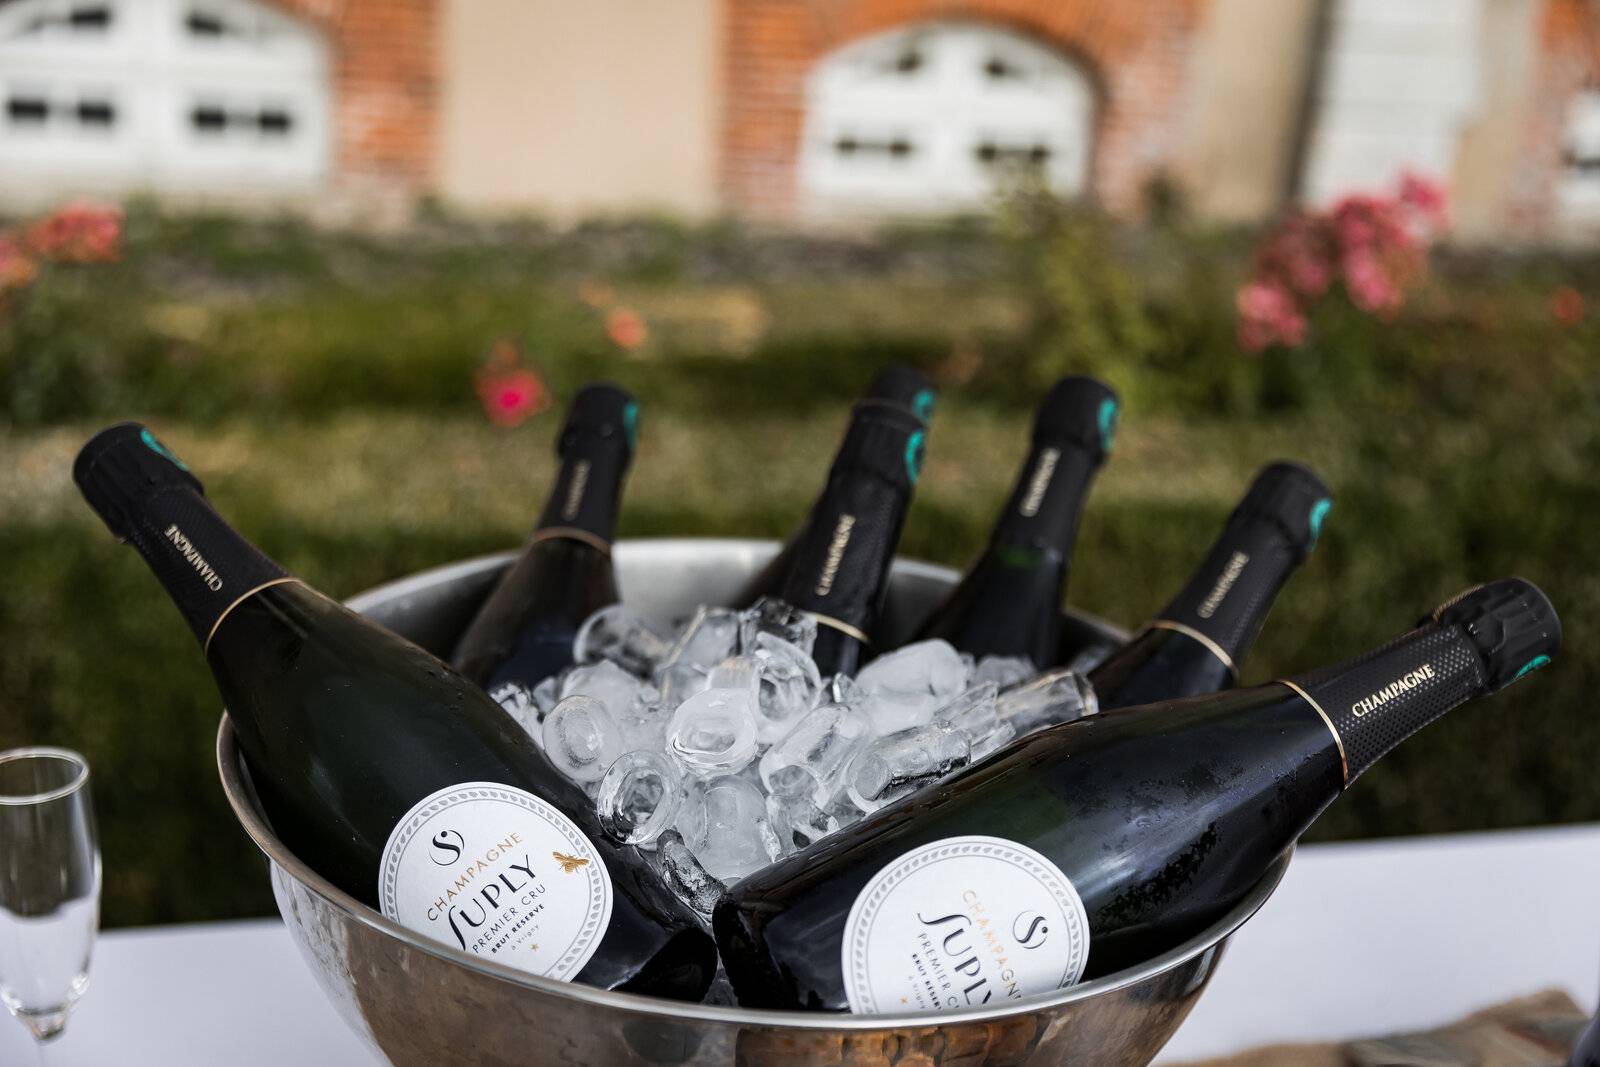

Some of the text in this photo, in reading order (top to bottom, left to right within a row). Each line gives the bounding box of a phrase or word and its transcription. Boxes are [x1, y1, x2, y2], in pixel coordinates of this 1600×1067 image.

[164, 523, 223, 592] CHAMPAGNE
[1352, 663, 1435, 718] CHAMPAGNE
[427, 831, 523, 922] CHAMPAGNE
[448, 854, 536, 951] SUPLY
[472, 884, 546, 953] PREMIER CRU
[491, 904, 545, 953] BRUT RESERVE
[963, 890, 1022, 999] CHAMPAGN
[918, 932, 952, 991] PREMIER
